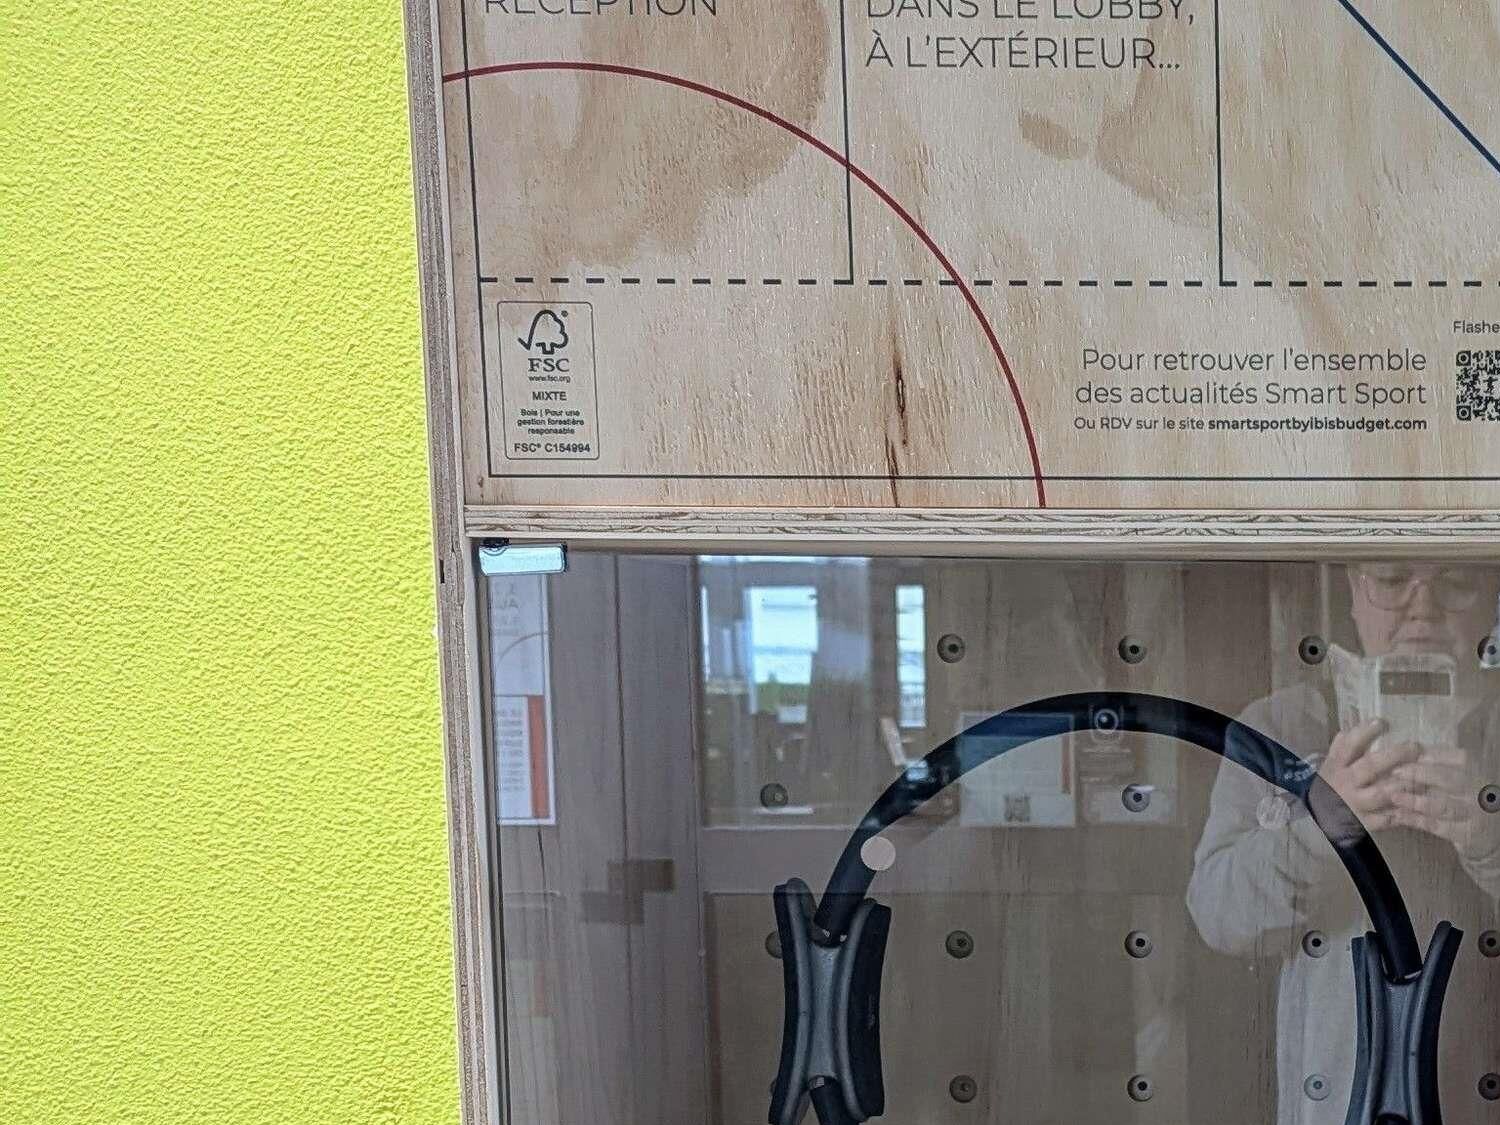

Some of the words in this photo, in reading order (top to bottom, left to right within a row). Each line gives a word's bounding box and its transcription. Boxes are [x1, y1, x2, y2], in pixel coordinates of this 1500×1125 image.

[865, 29, 894, 68] À
[527, 357, 570, 373] FSC
[1082, 348, 1145, 371] Pour
[1154, 350, 1275, 371] retrouver
[1283, 347, 1427, 371] l'ensemble
[532, 391, 568, 401] MIXTE
[1075, 381, 1123, 404] des
[1130, 381, 1258, 404] actualités
[1265, 382, 1347, 405] Smart
[1354, 382, 1427, 409] Sport
[1074, 416, 1096, 430] Ou
[1100, 416, 1133, 430] RDV
[1136, 419, 1159, 430] sur
[1162, 416, 1176, 430] le
[1178, 416, 1205, 430] site
[1208, 415, 1428, 432] smartsportbyibisbudget.com
